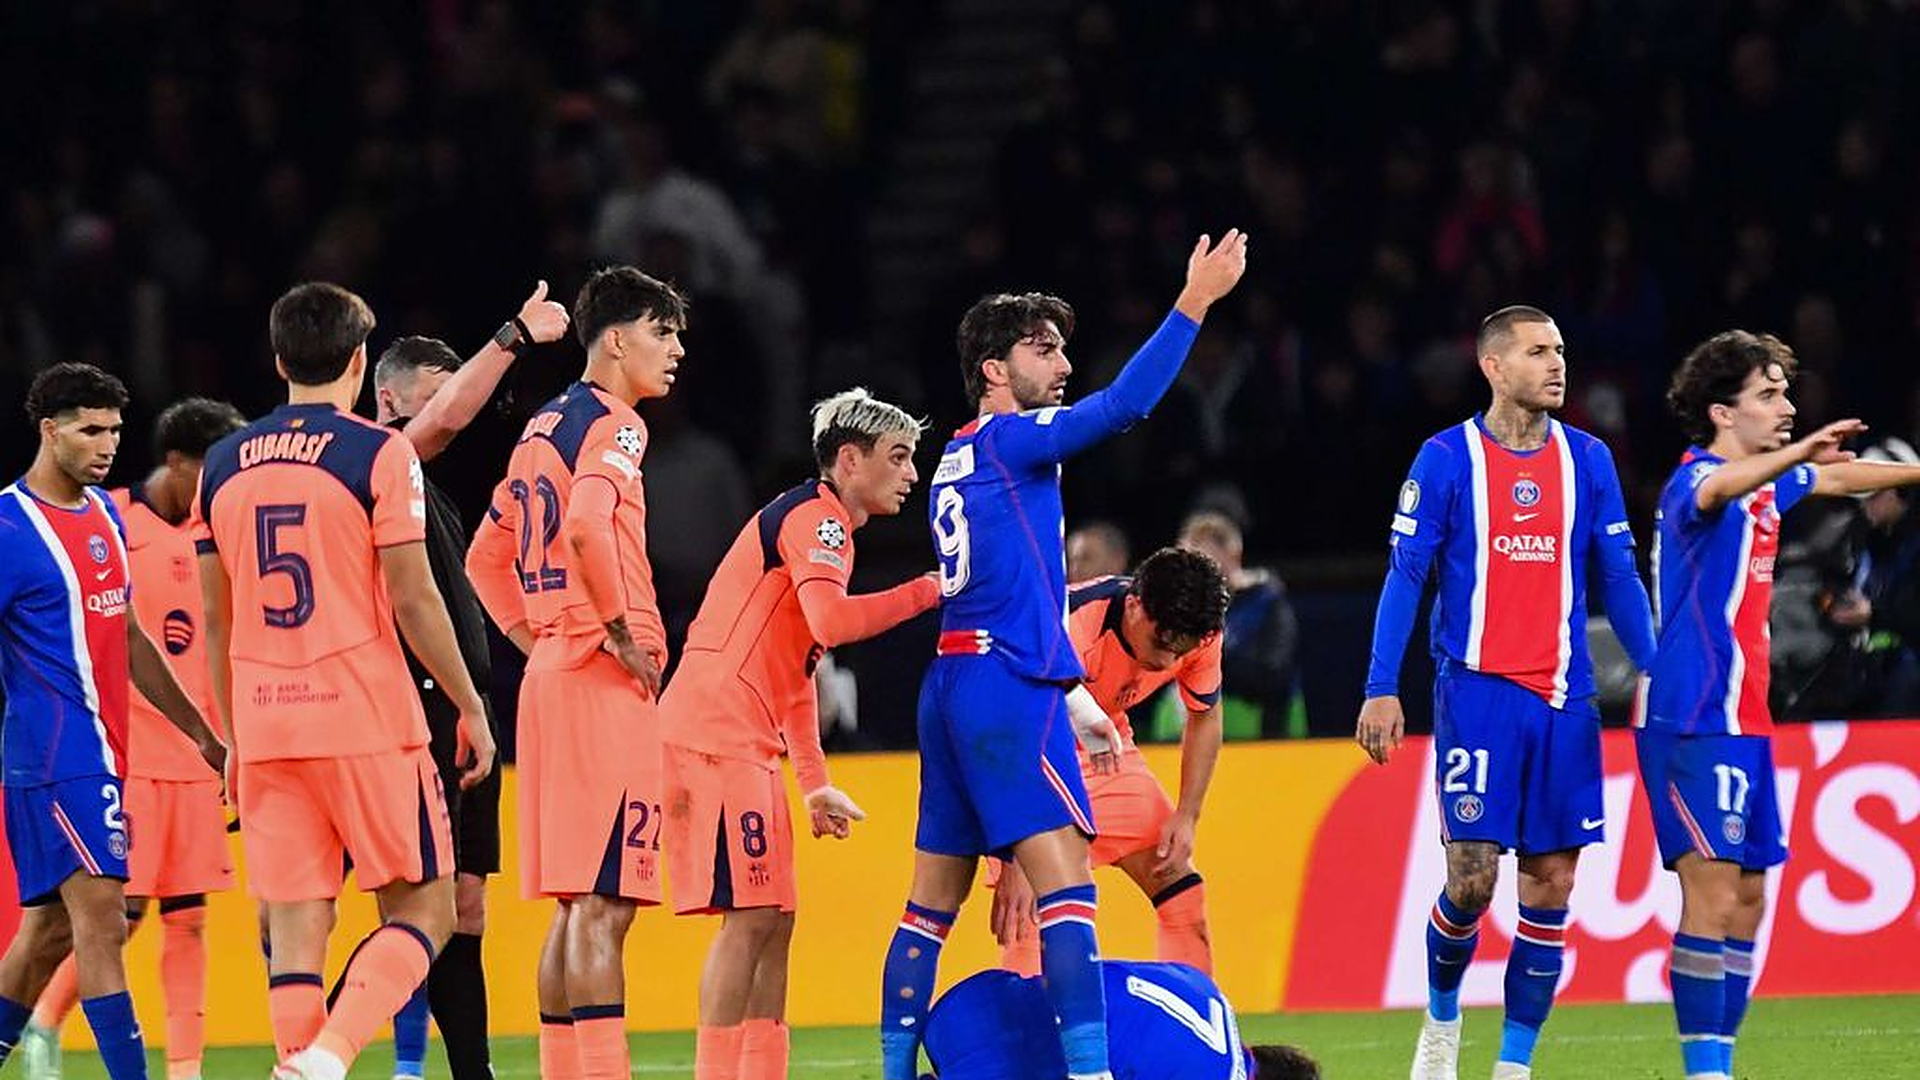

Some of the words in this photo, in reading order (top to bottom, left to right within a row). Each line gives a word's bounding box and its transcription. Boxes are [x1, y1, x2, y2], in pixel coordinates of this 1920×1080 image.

[933, 484, 970, 598] 9
[1493, 533, 1556, 555] QATAR
[1510, 551, 1556, 563] AIRWAYS
[255, 503, 316, 630] 5
[1444, 747, 1489, 794] 21
[1713, 763, 1749, 813] 17
[101, 783, 124, 830] 2
[739, 810, 768, 859] 8
[1126, 975, 1228, 1055] 7
